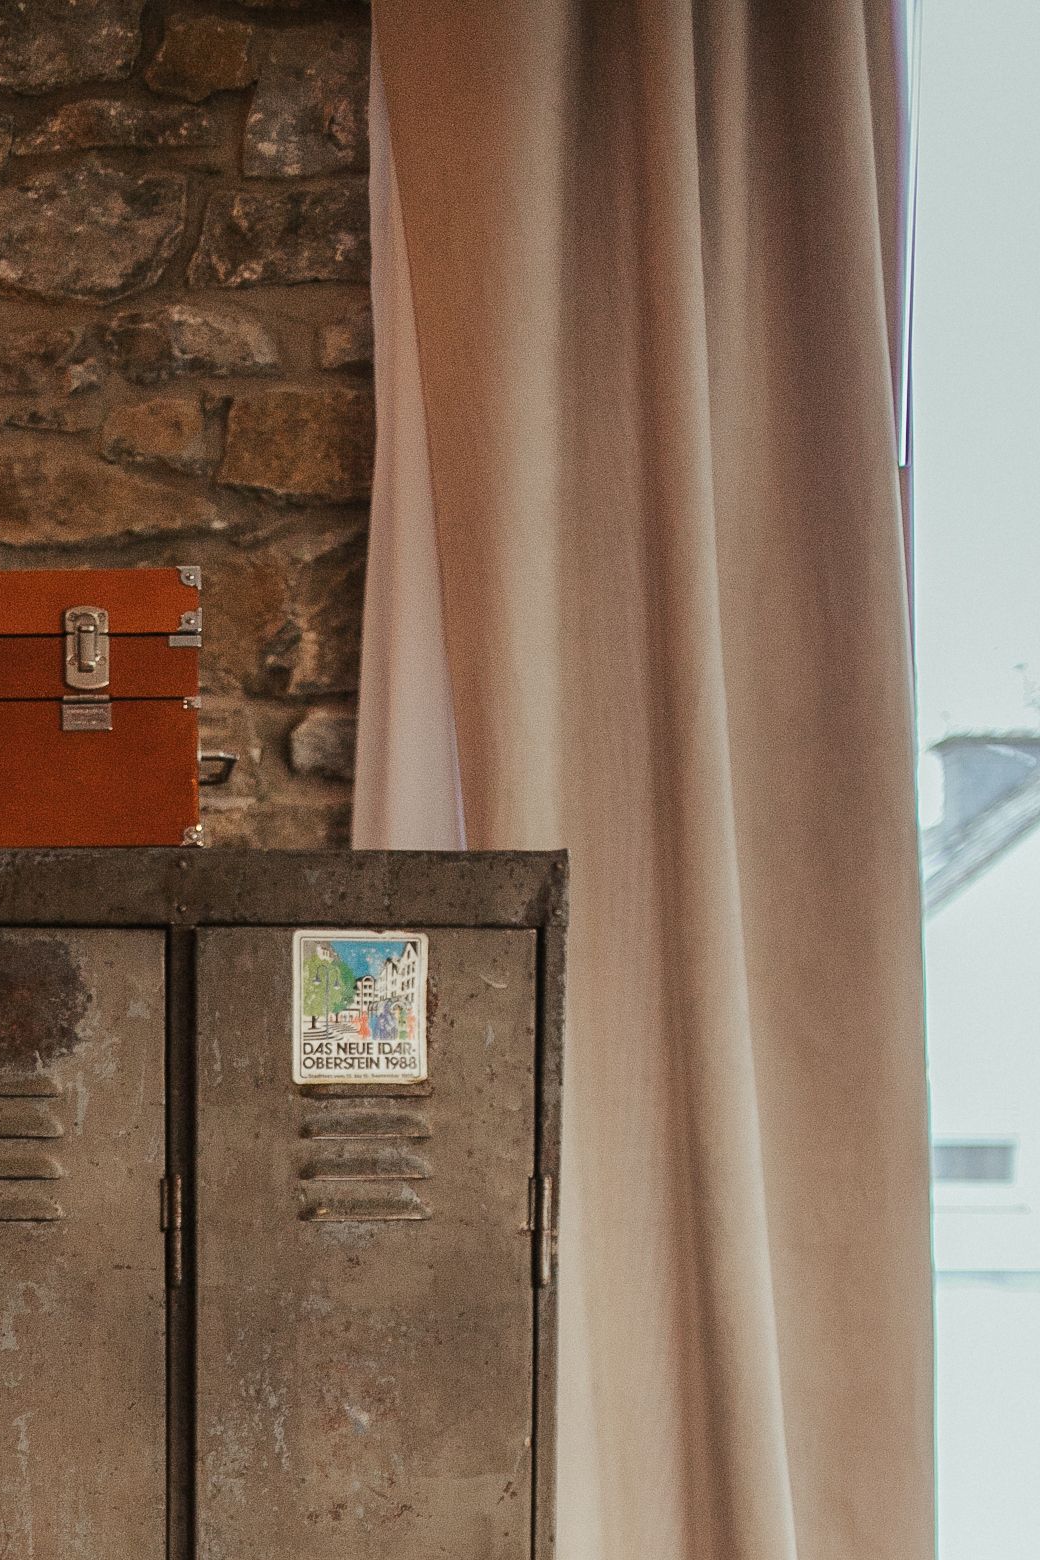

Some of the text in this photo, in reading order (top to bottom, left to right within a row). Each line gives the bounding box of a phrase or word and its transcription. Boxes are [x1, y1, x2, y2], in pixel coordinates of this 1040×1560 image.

[303, 1042, 416, 1055] DAS NEUE IDAR-
[303, 1056, 380, 1069] OBERSTEIN
